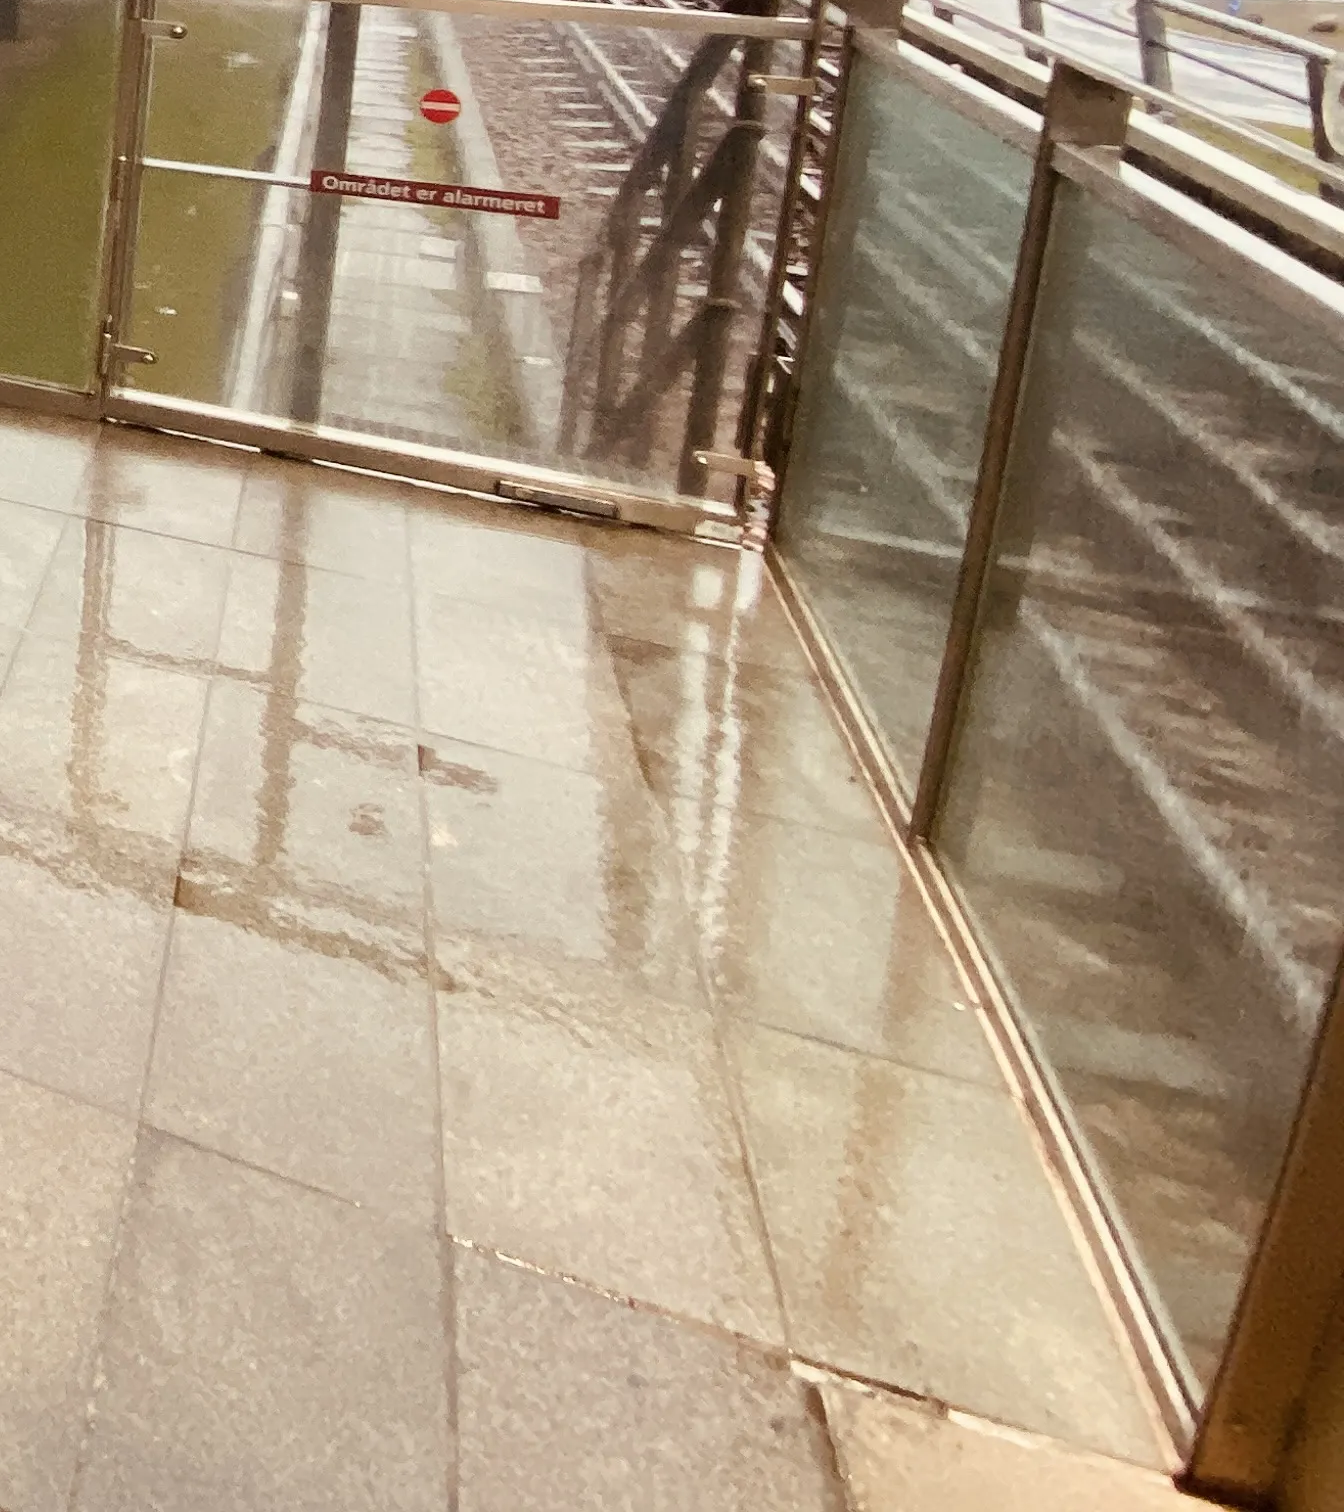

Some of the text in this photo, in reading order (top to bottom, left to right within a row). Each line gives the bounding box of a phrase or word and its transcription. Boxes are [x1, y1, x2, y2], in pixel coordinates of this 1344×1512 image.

[322, 175, 546, 214] Området er alarmeret
